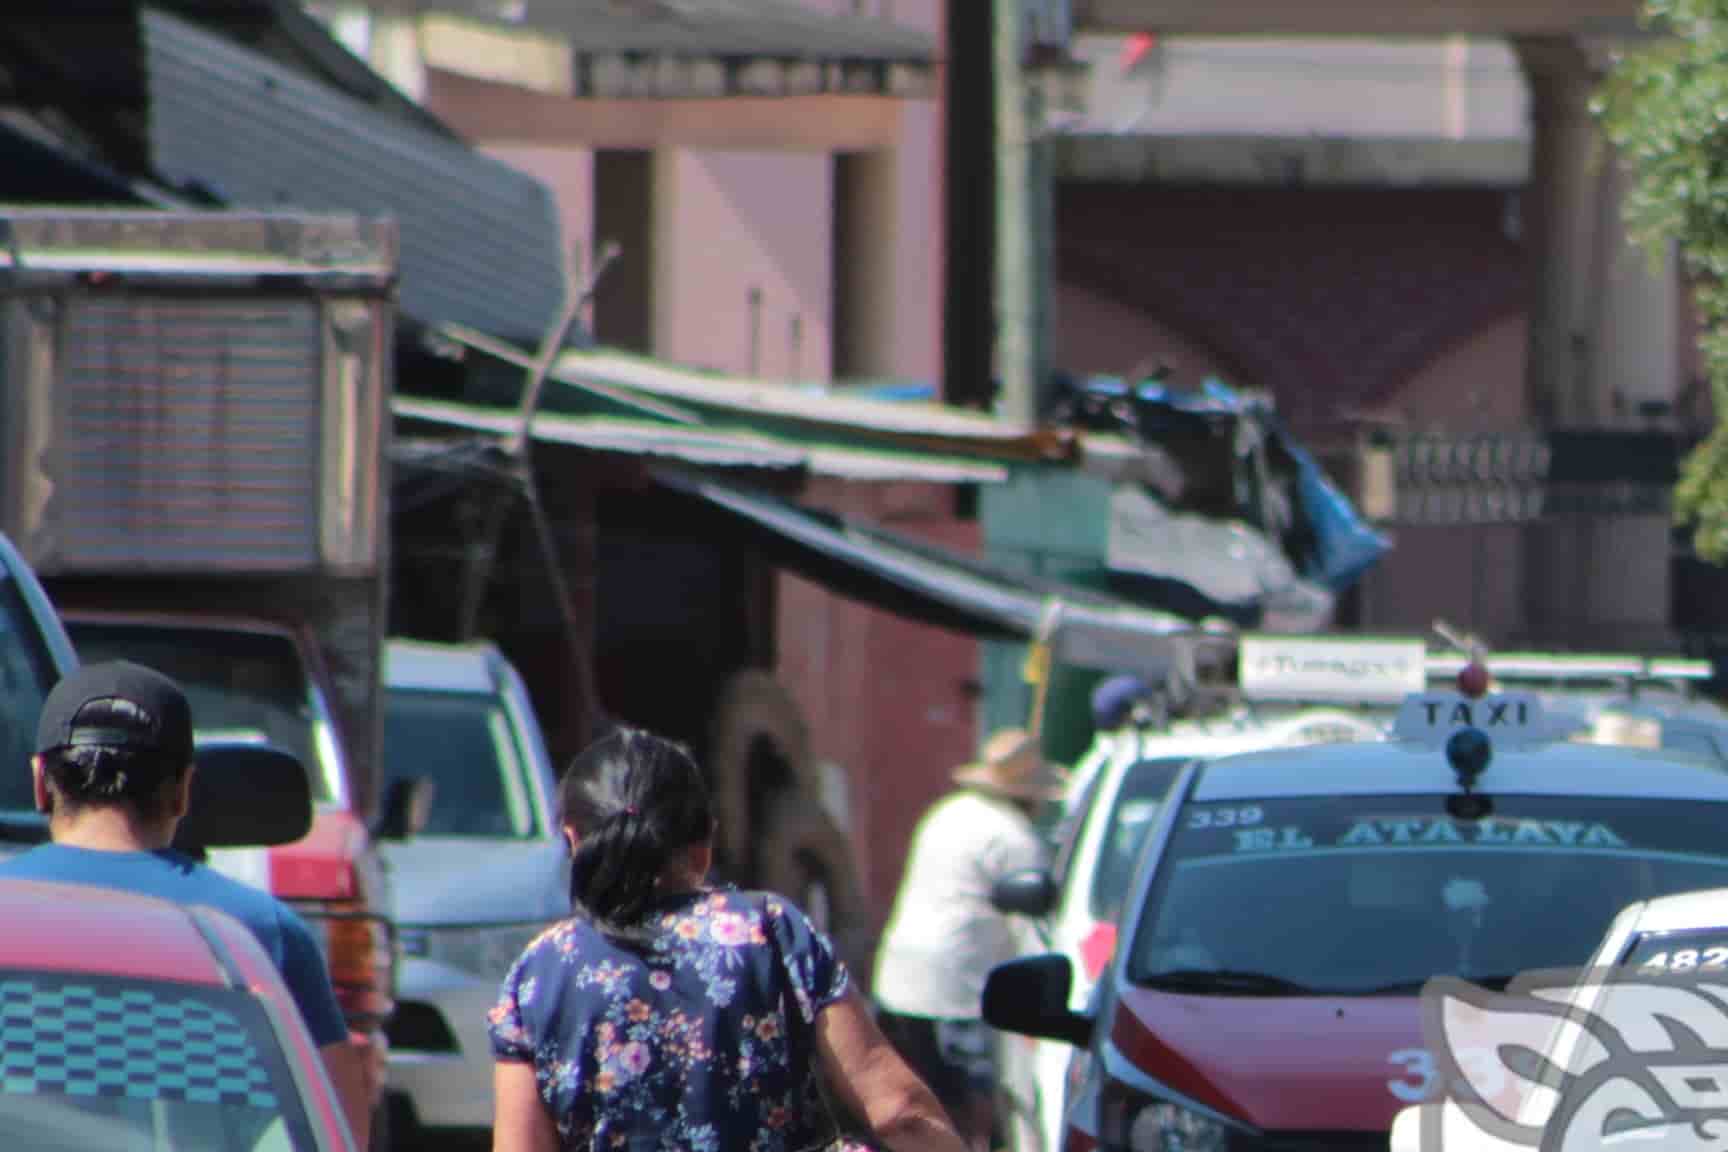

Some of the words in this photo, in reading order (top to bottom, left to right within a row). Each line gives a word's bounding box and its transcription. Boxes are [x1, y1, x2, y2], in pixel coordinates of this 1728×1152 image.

[1424, 700, 1529, 726] TAXI
[1188, 804, 1265, 829] 339
[1234, 828, 1313, 851] EL
[1343, 817, 1627, 846] ATALAYA
